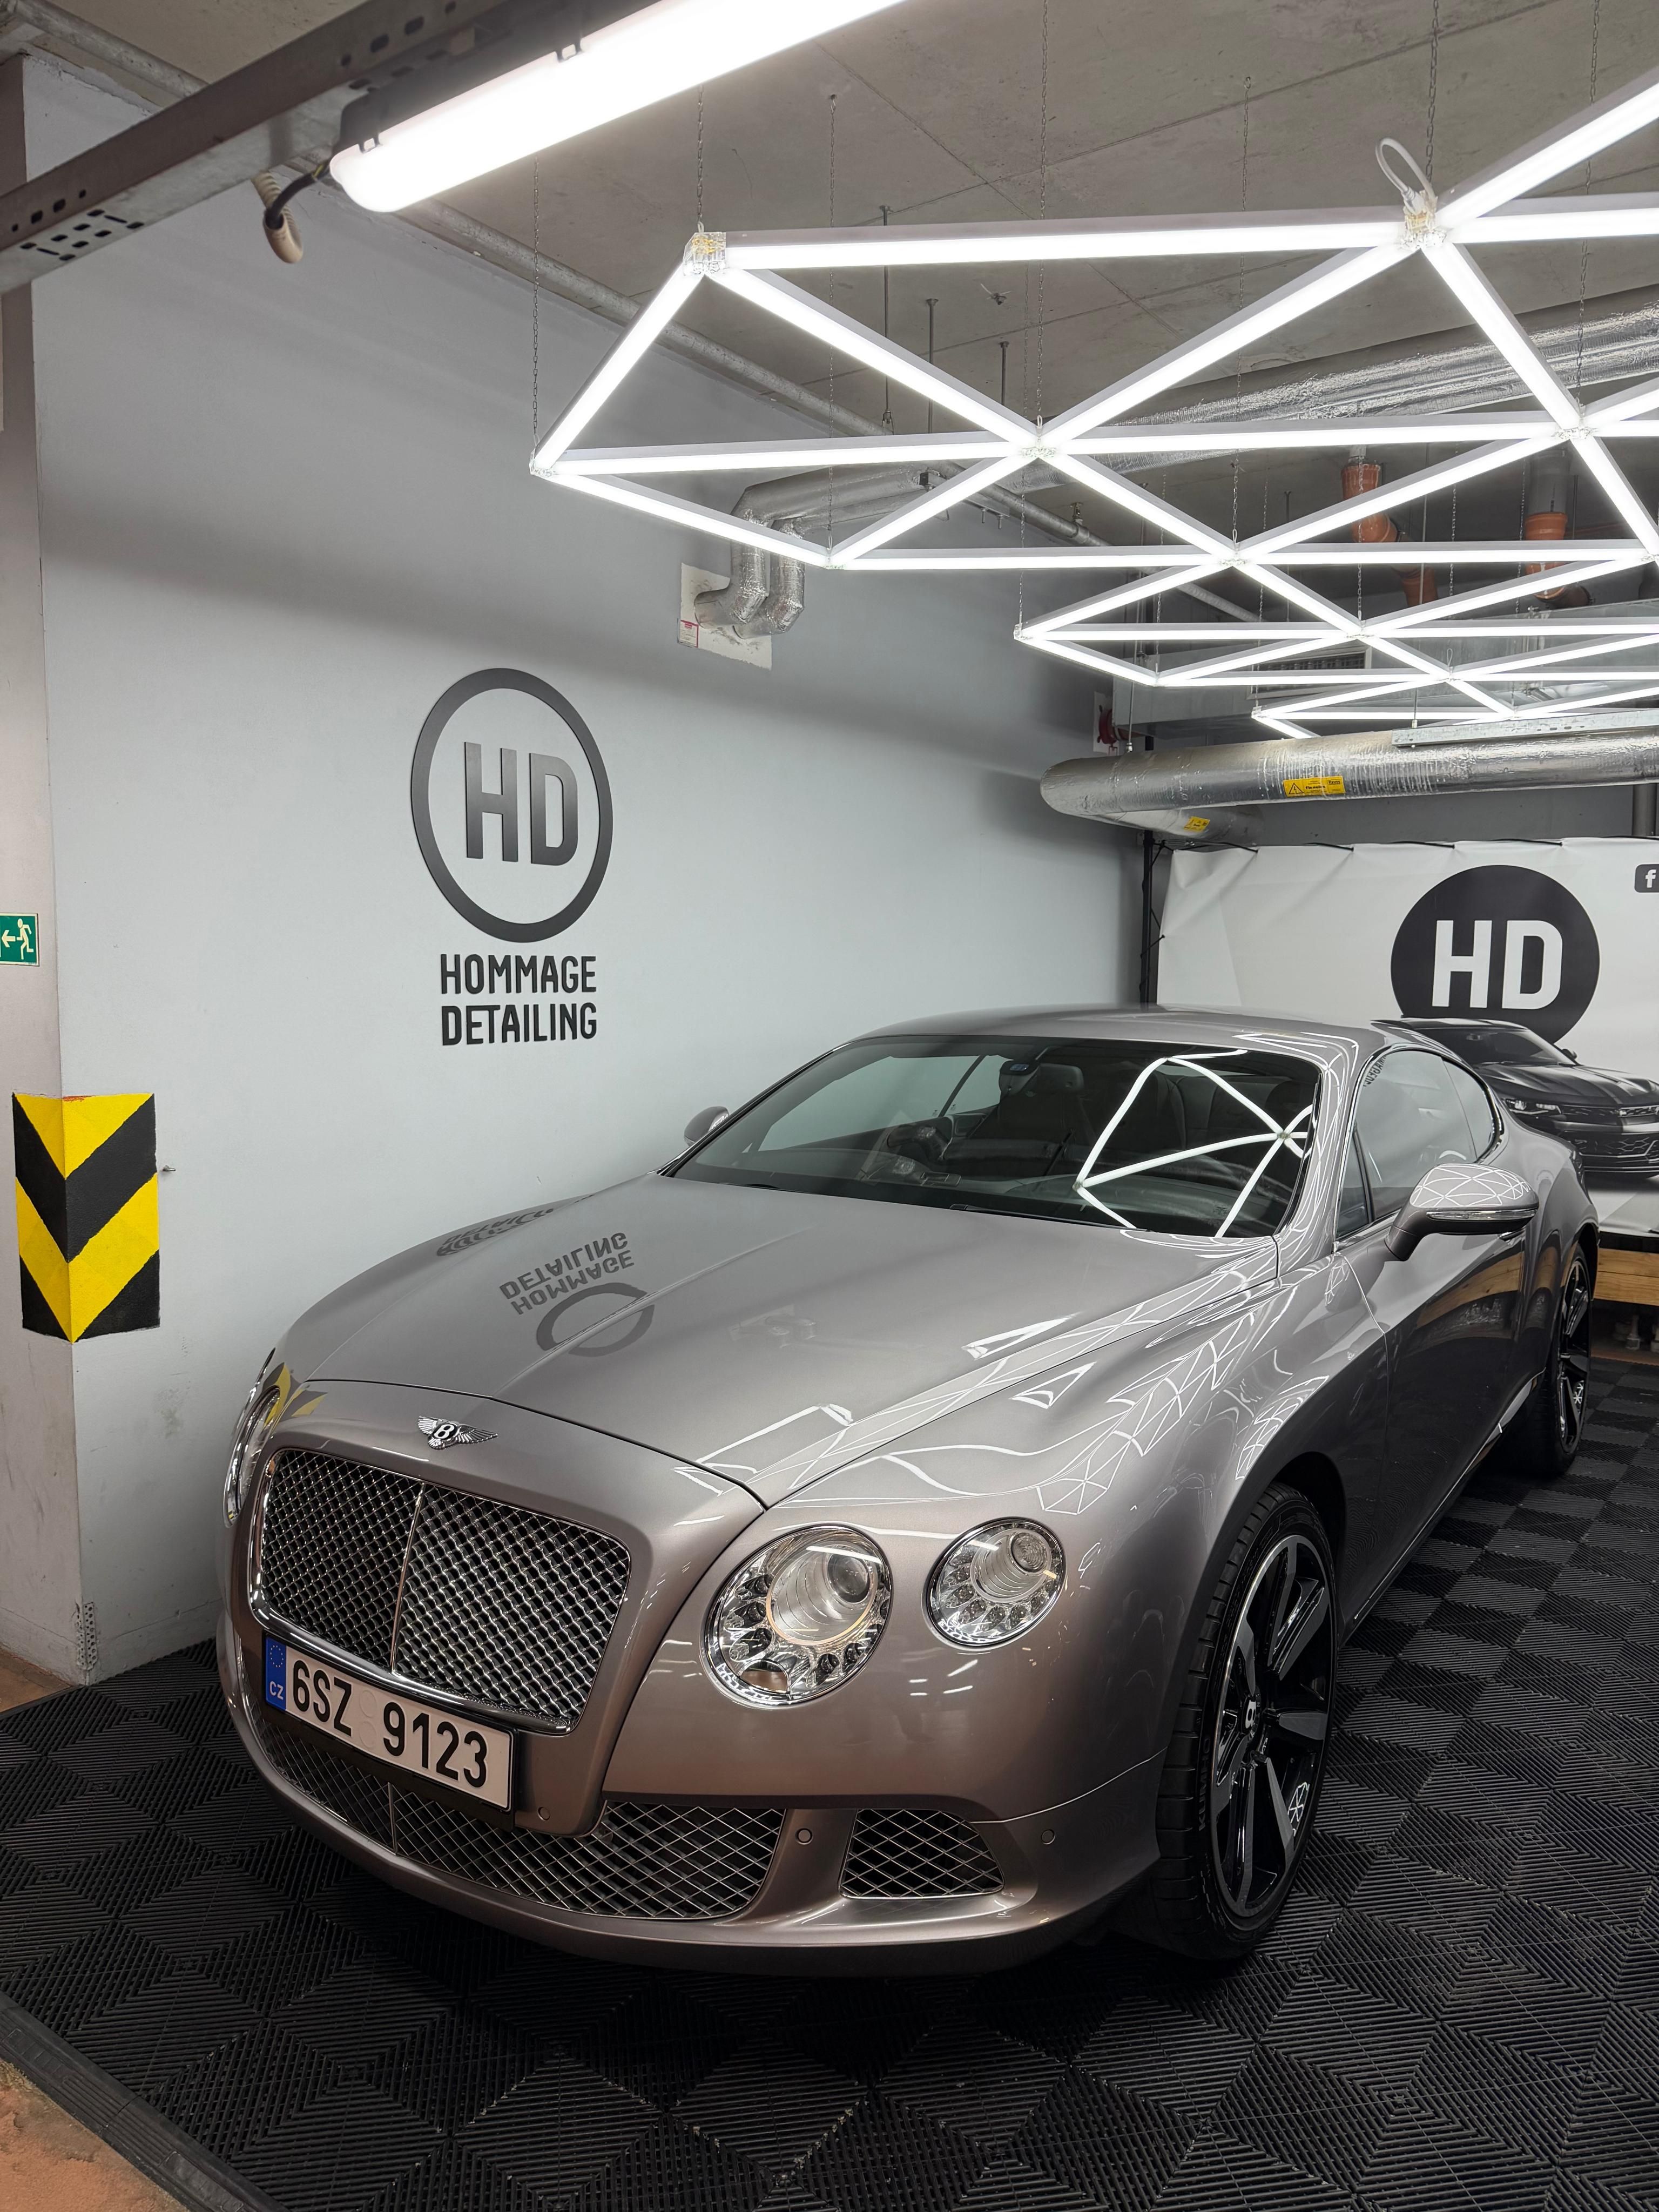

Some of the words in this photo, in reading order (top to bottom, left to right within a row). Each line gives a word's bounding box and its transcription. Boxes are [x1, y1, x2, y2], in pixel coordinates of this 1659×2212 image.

[464, 741, 578, 866] HD
[1645, 869, 1657, 888] f
[441, 954, 597, 994] HOMMAGE
[1432, 920, 1563, 1009] HD
[442, 1002, 597, 1046] DETAILING
[433, 1424, 455, 1439] B
[269, 1681, 284, 1700] CZ
[293, 1660, 352, 1737] 6SZ
[383, 1702, 487, 1788] 9123
